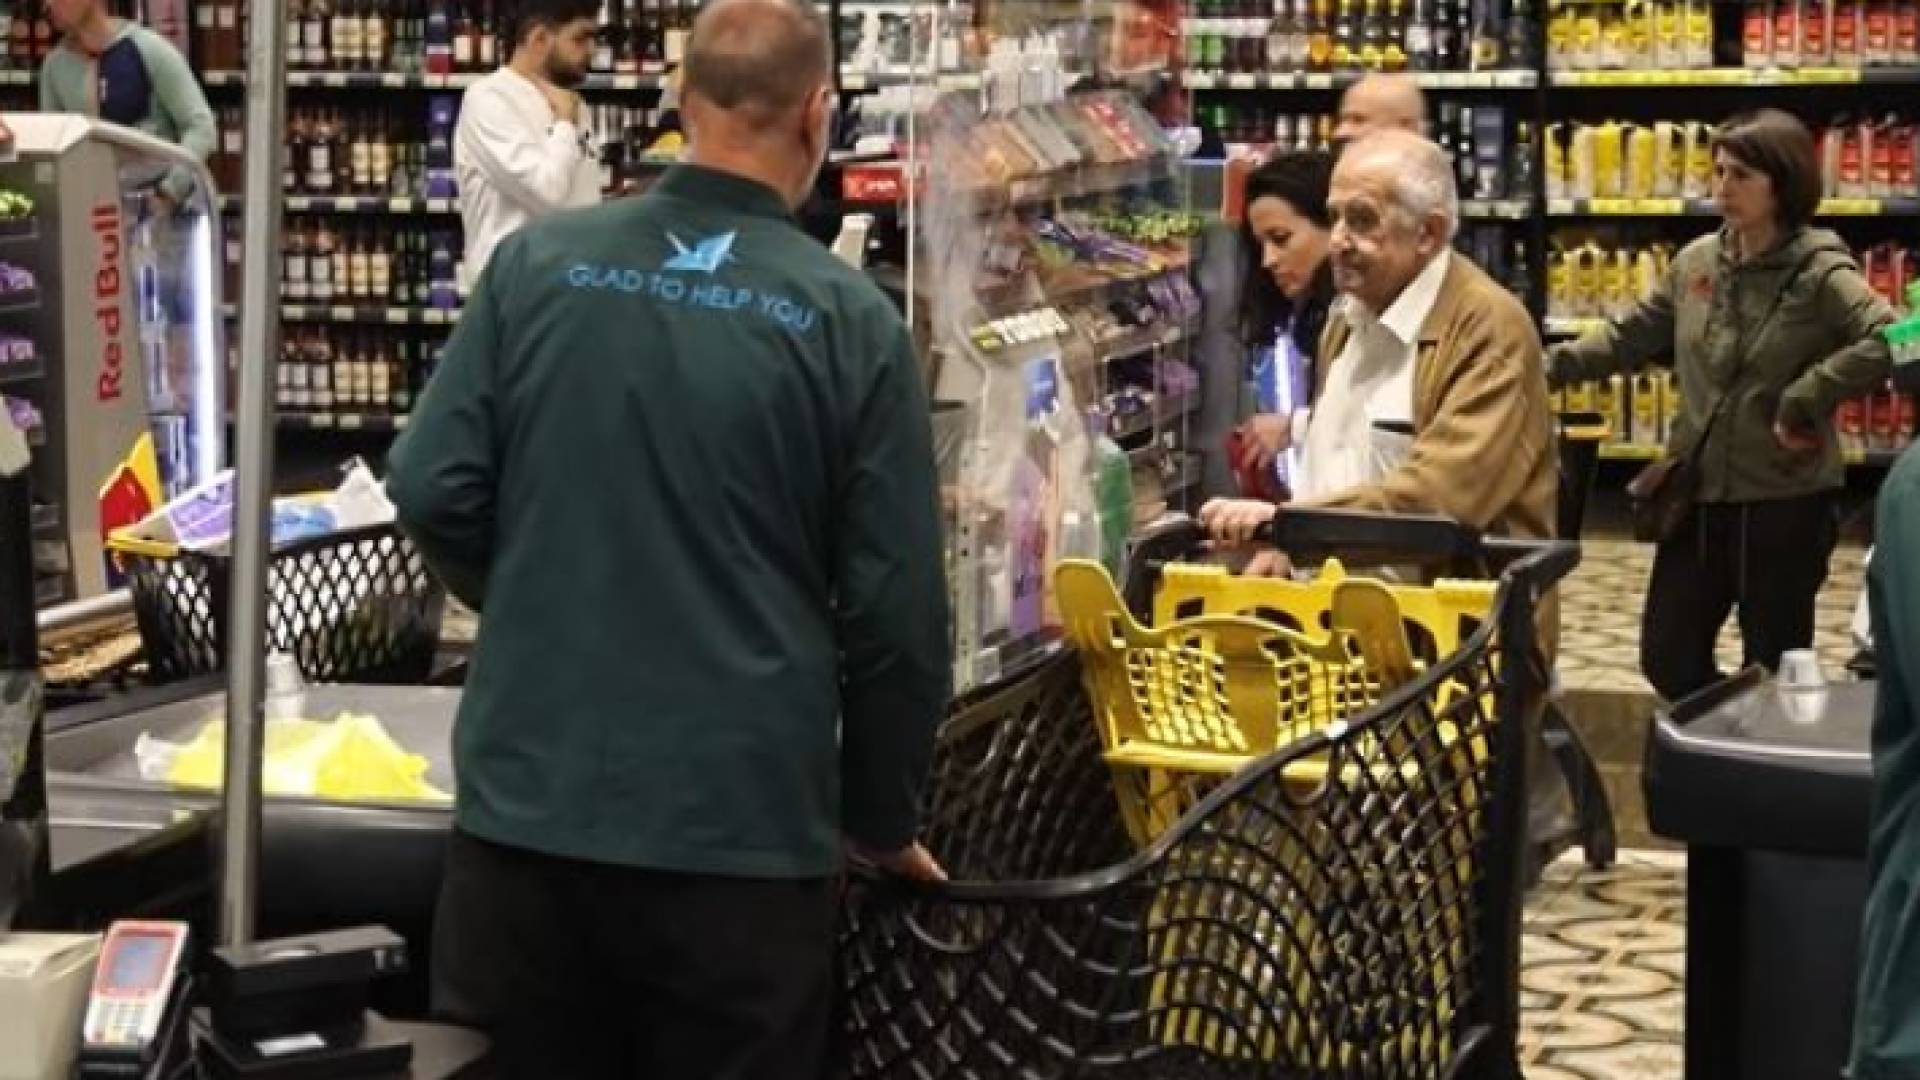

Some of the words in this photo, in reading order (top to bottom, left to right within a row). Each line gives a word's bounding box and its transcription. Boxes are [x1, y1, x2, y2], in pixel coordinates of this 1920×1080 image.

[91, 204, 120, 297] Bull
[568, 264, 643, 292] GLAD
[652, 273, 684, 300] TO
[688, 285, 751, 309] HELP
[758, 292, 816, 332] YOU
[96, 306, 122, 401] Red
